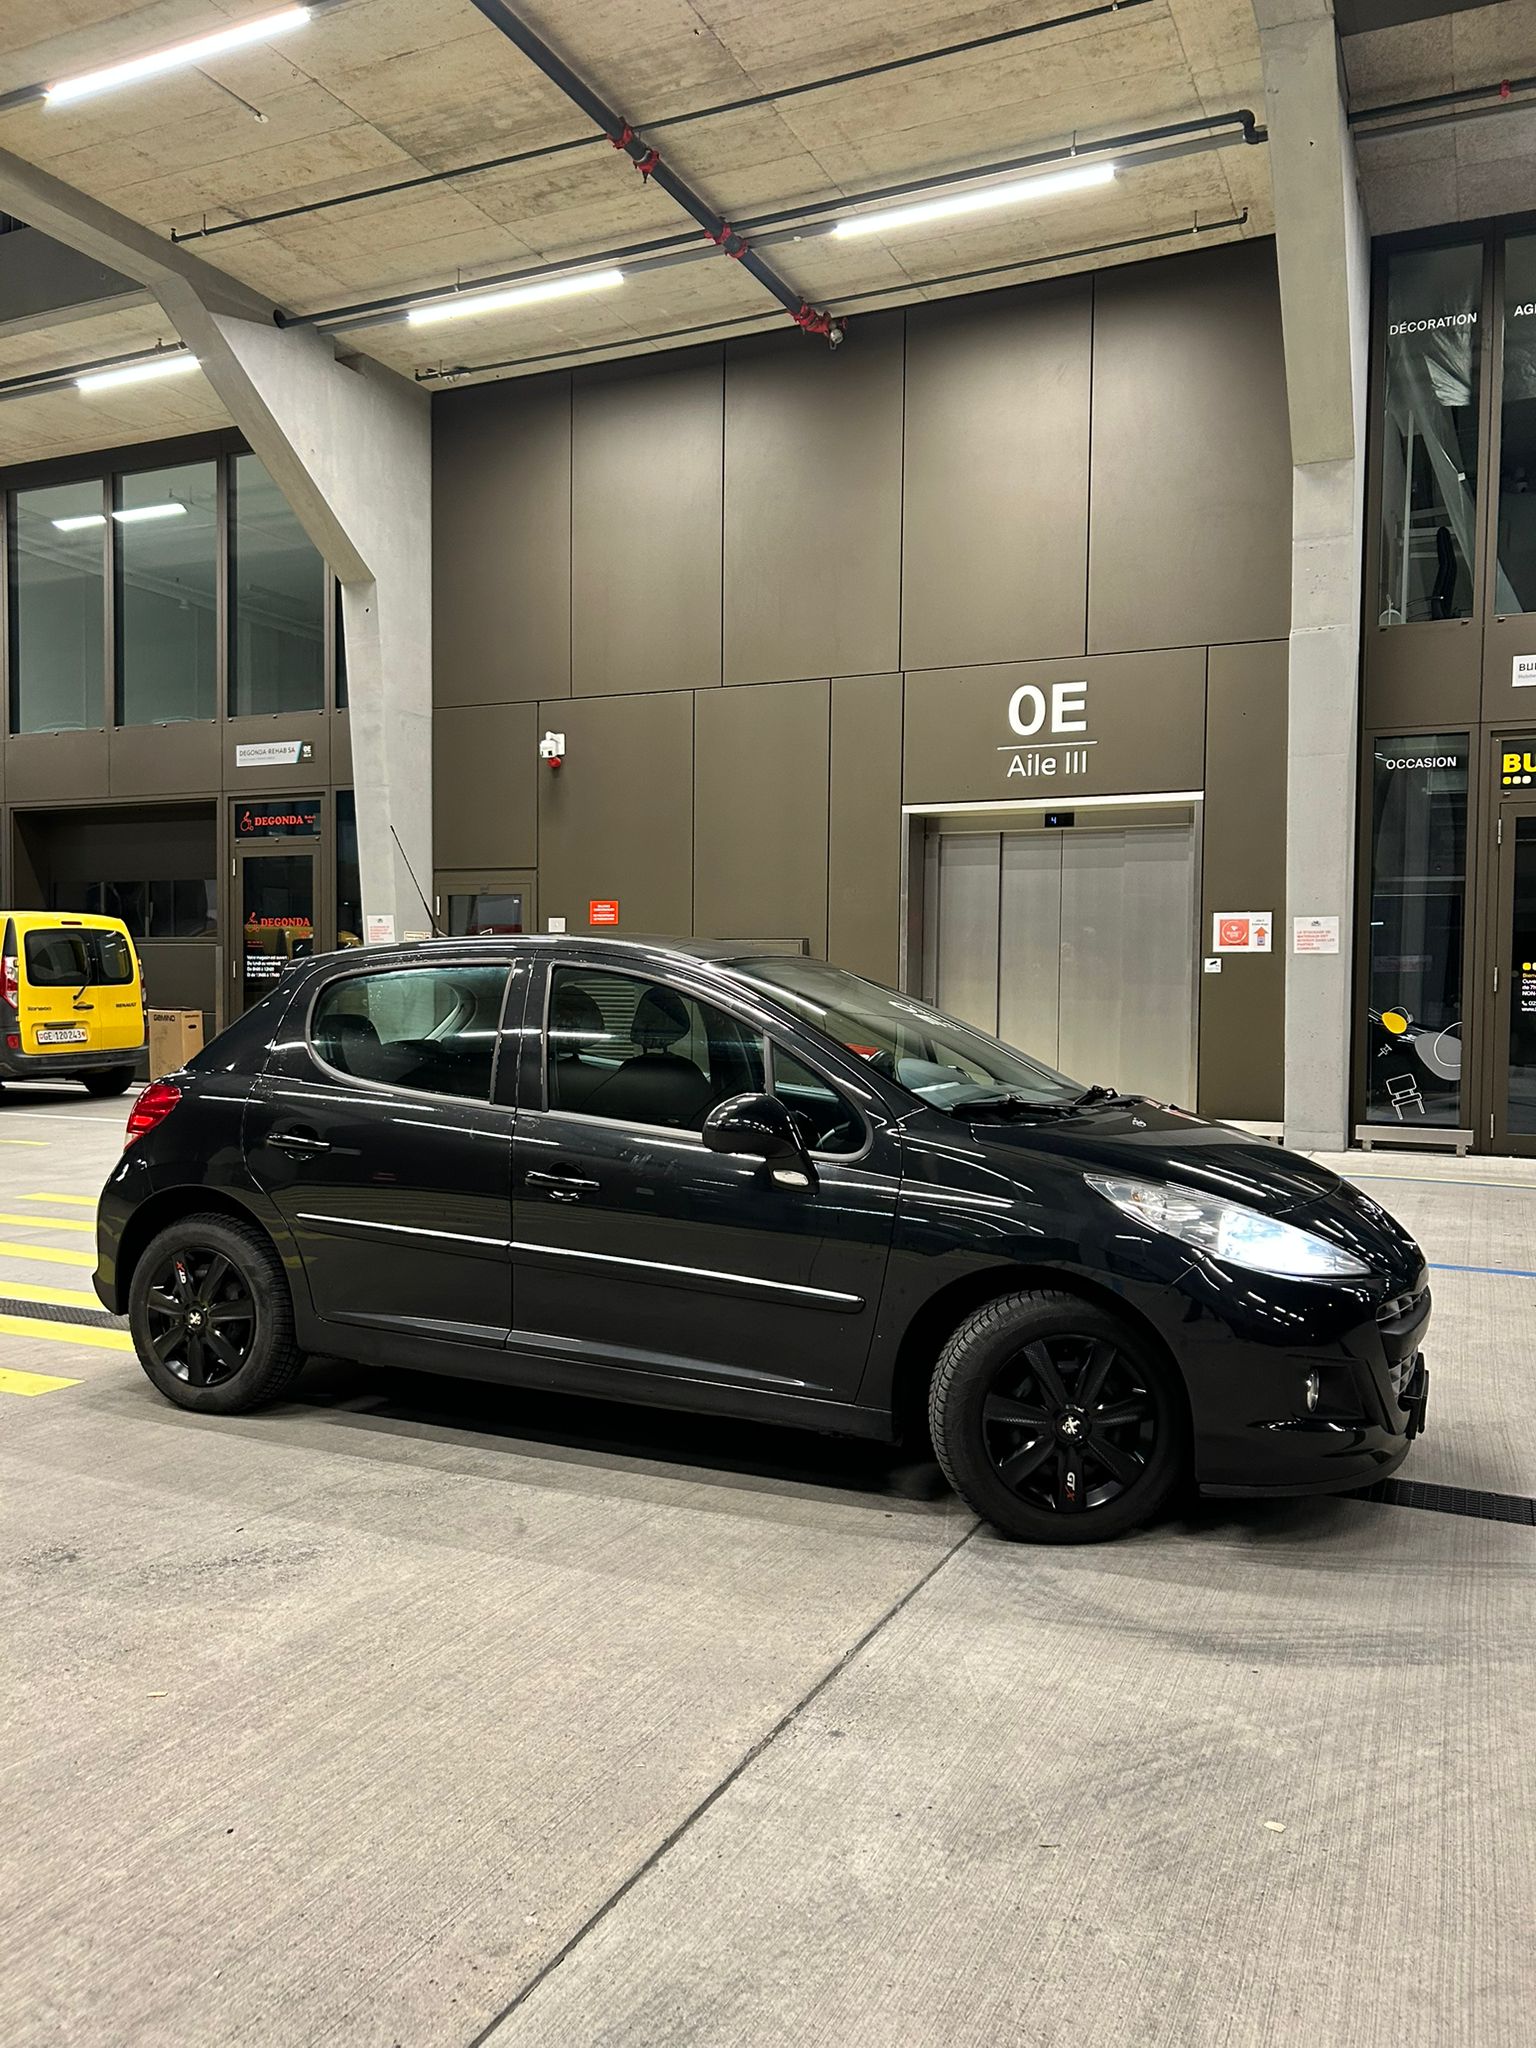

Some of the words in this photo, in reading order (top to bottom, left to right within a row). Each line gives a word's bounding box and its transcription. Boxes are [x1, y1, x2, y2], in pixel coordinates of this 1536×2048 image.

[1513, 303, 1536, 317] AG
[1389, 312, 1477, 335] DÉCORATION
[239, 749, 267, 757] DEGONDA
[1007, 753, 1057, 777] Aile
[1065, 750, 1088, 774] III
[1385, 756, 1457, 770] OCCASION
[254, 815, 304, 826] DEGONDA
[260, 917, 311, 927] DEGONDA
